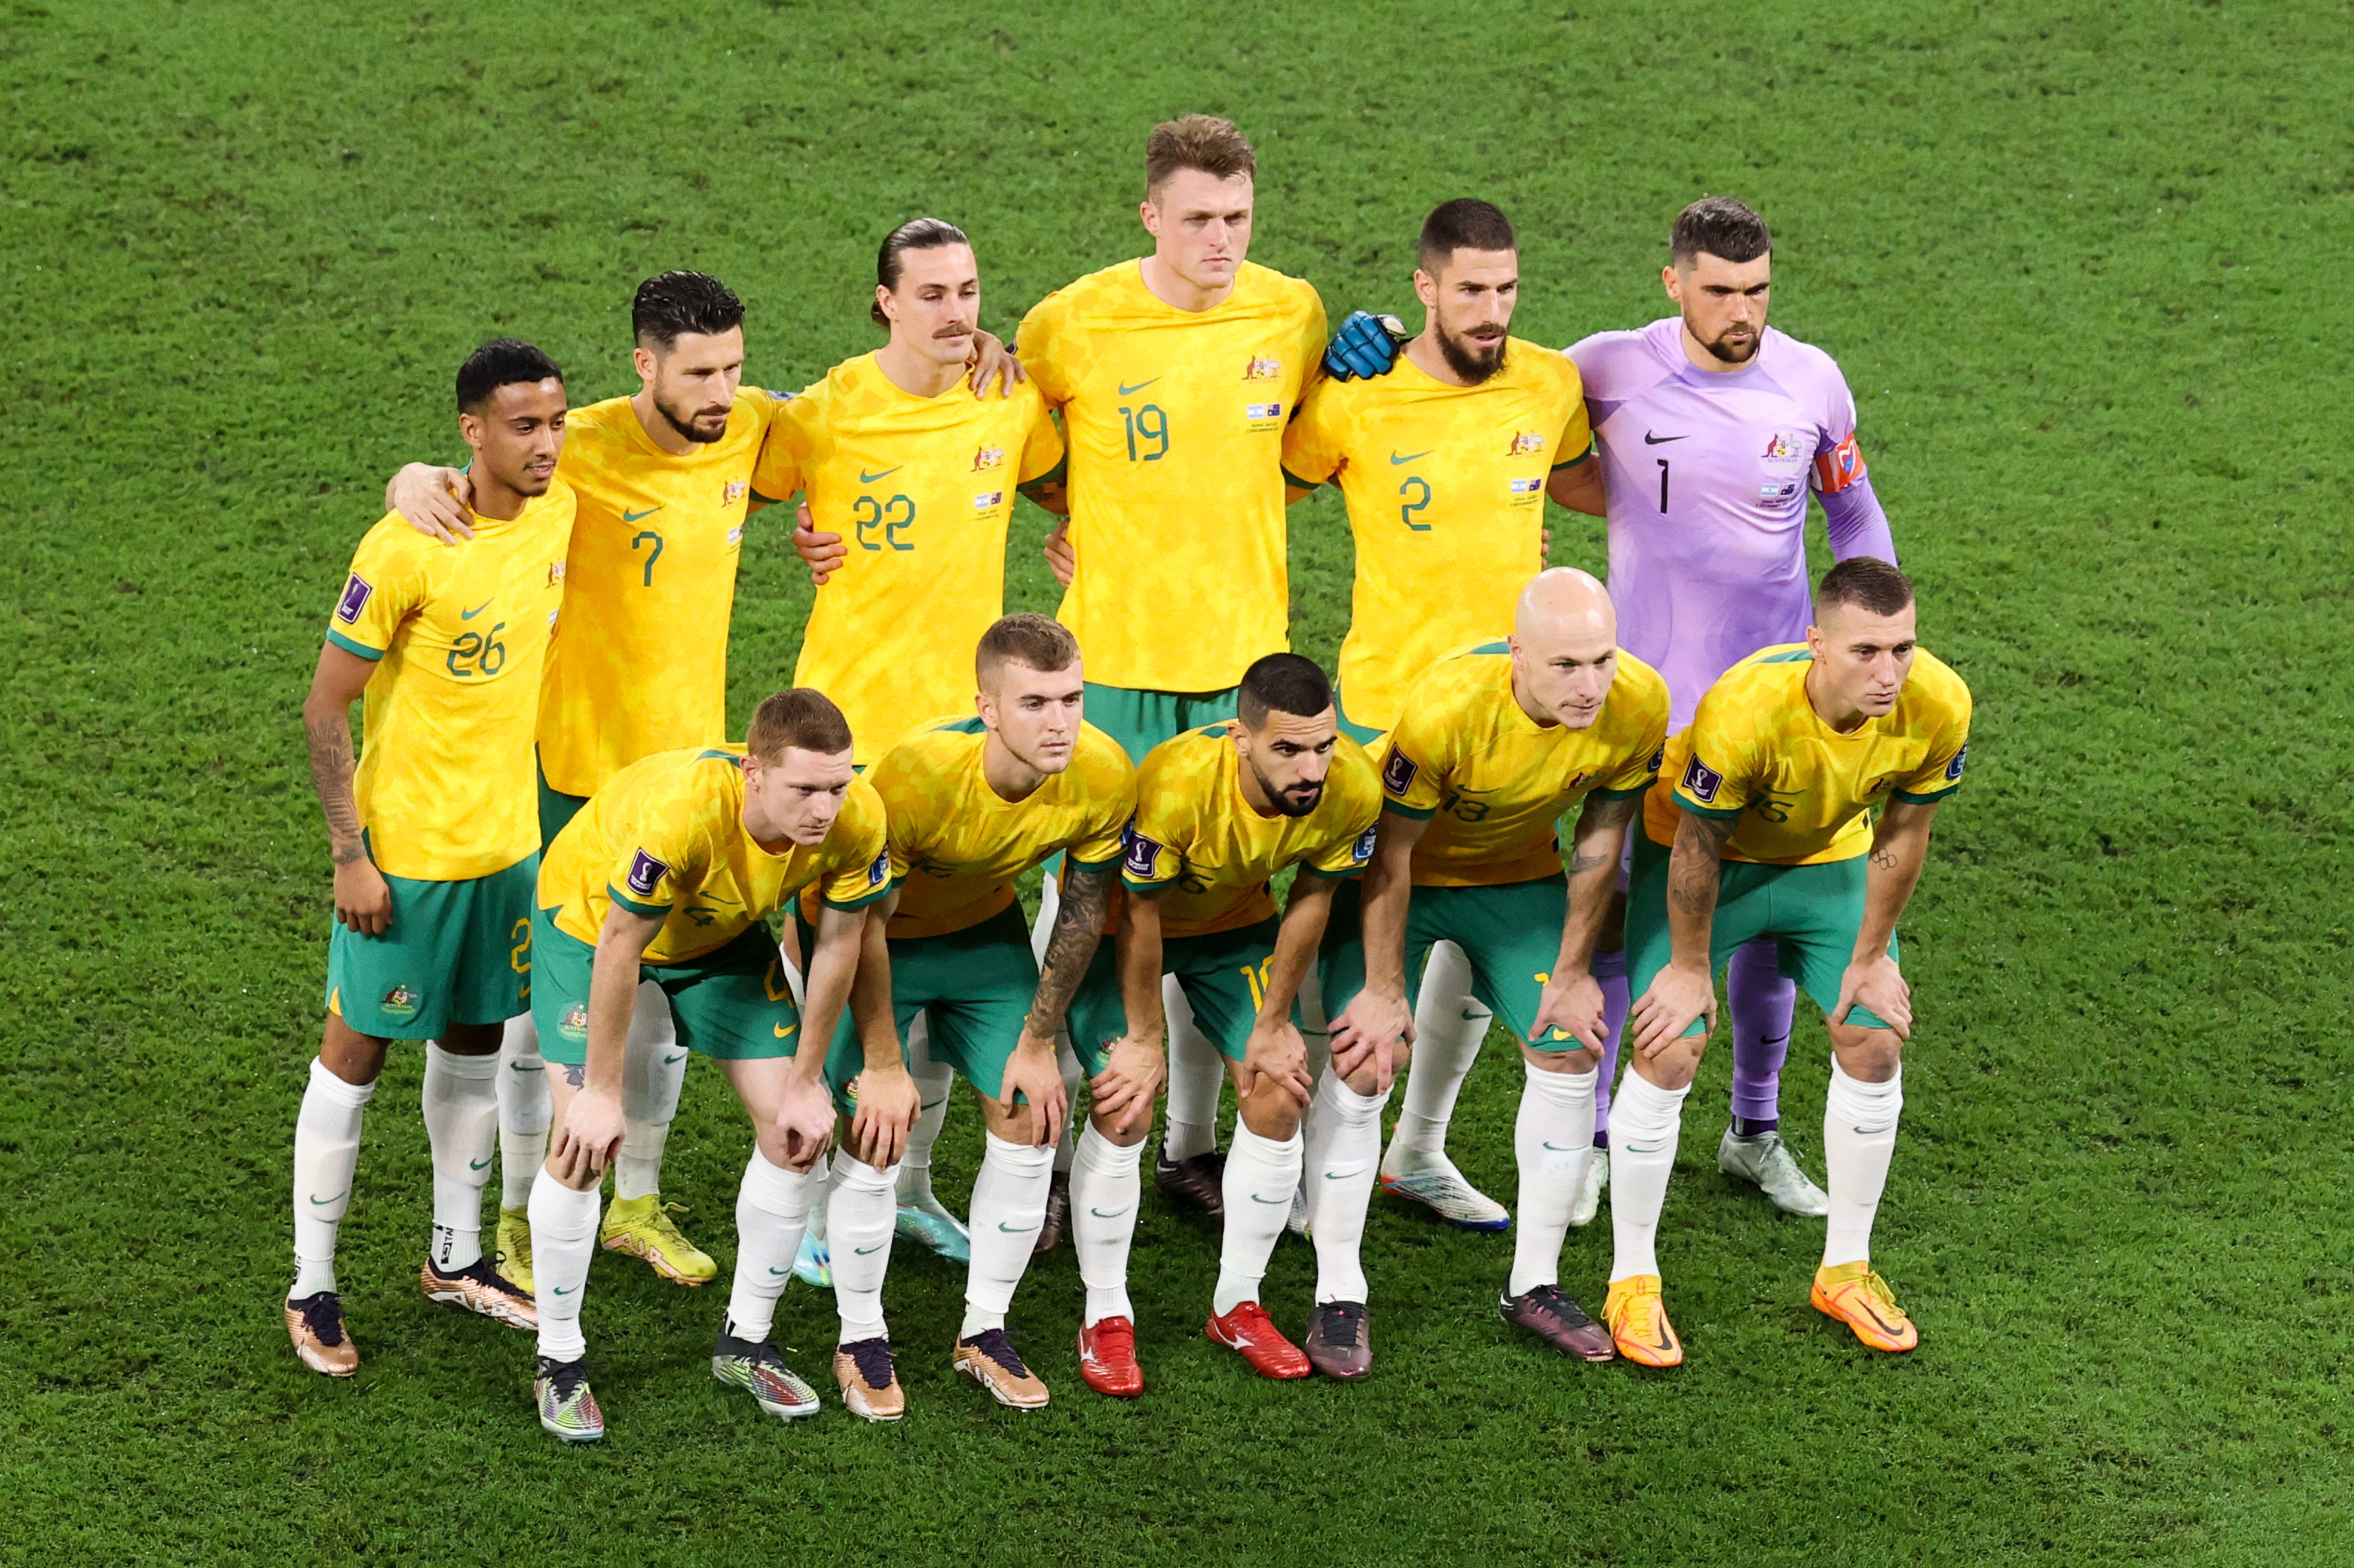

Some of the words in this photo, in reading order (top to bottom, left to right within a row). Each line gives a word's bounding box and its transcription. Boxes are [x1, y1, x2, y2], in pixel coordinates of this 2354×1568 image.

[1118, 405, 1169, 462] 19
[1399, 477, 1432, 531] 2
[1657, 459, 1669, 514] 1
[853, 494, 915, 551] 22
[632, 532, 663, 587] 7
[447, 621, 506, 676] 26
[1444, 789, 1490, 822] 13
